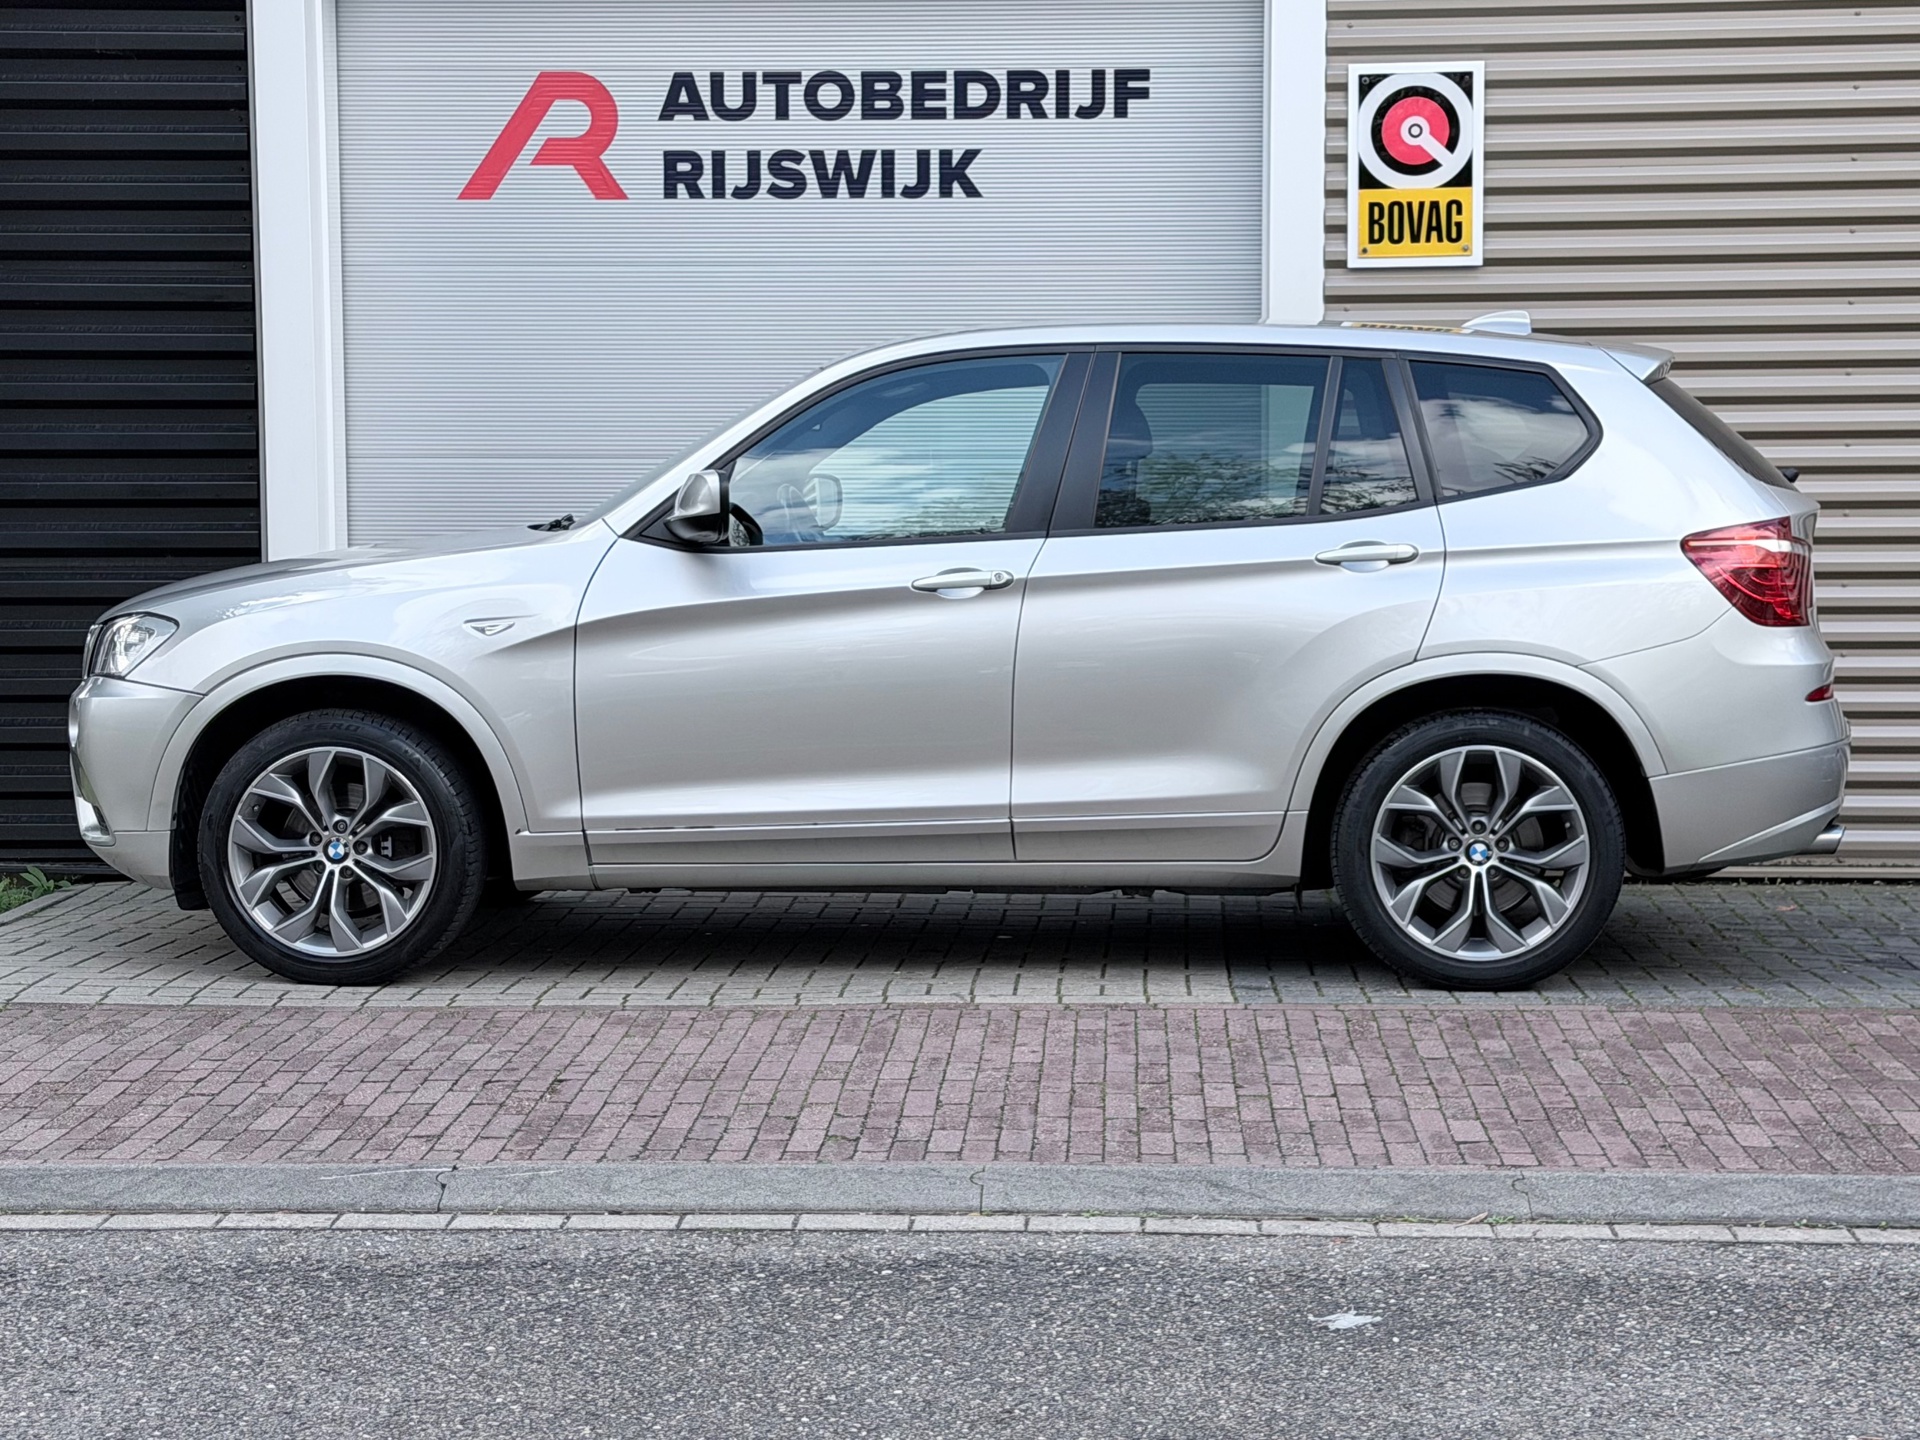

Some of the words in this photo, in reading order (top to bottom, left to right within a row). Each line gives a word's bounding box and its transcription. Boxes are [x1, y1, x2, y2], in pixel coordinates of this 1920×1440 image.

[657, 68, 1151, 122] AUTOBEDRIJF
[663, 148, 982, 200] RIJSWIJK
[1368, 199, 1463, 245] BOVAG
[302, 722, 360, 734] ZERO
